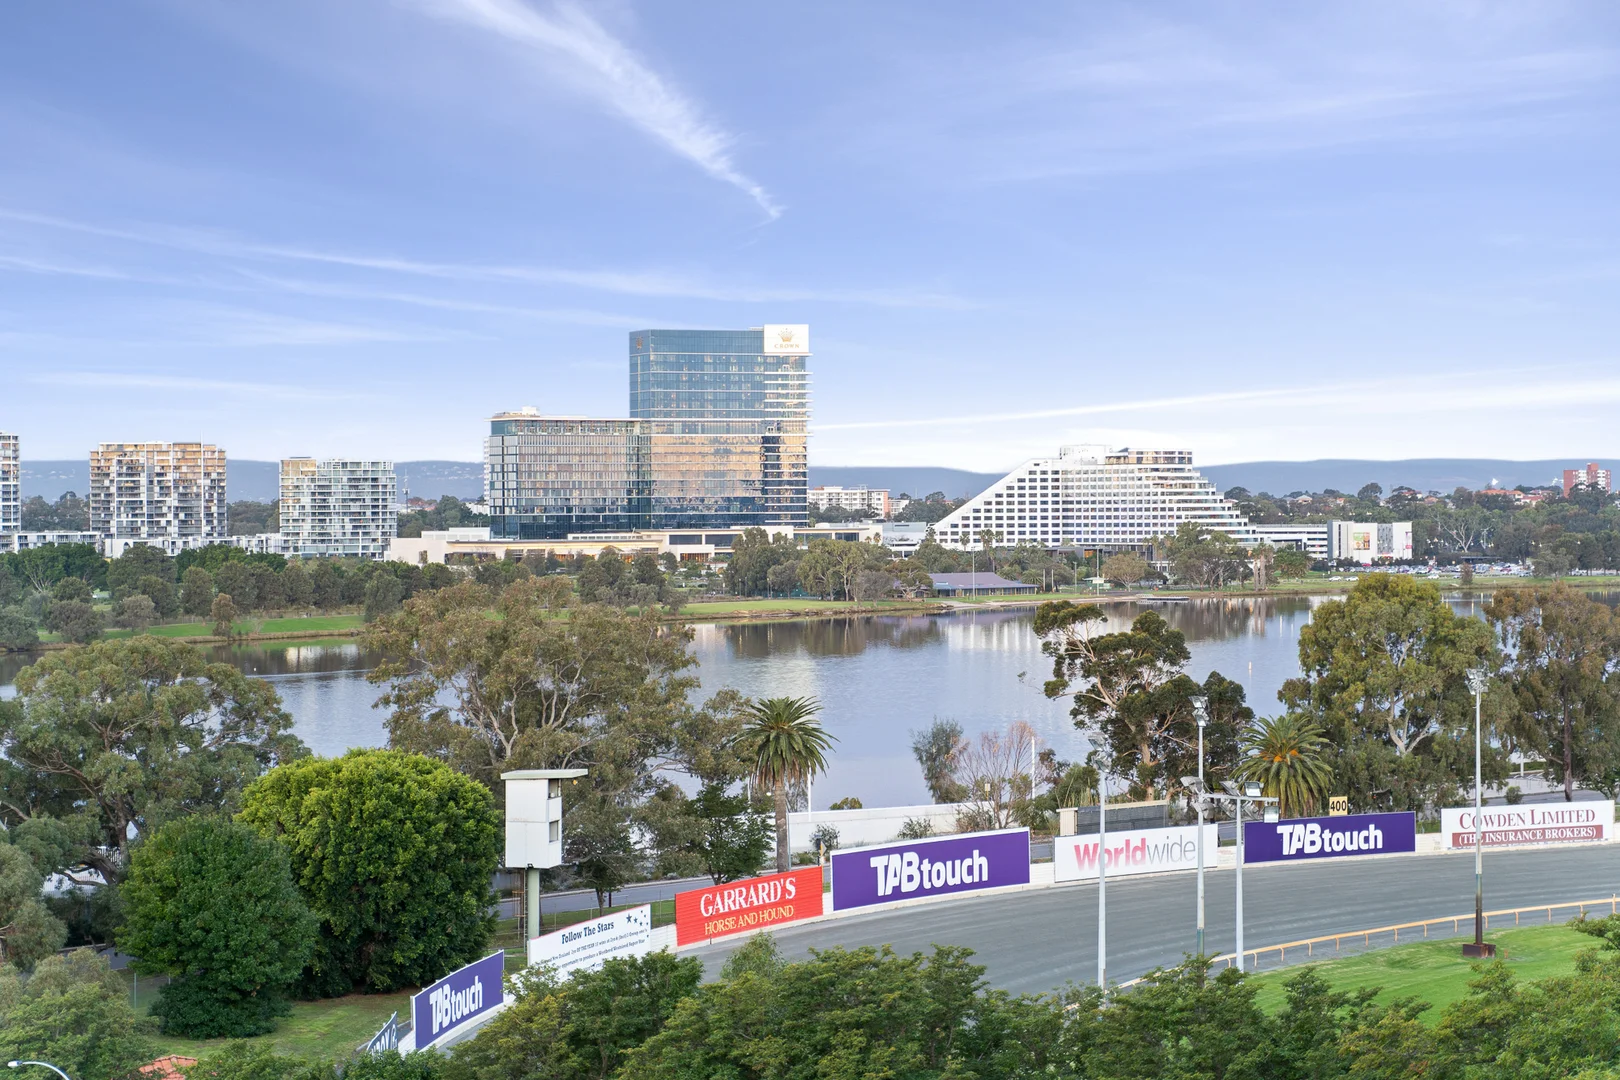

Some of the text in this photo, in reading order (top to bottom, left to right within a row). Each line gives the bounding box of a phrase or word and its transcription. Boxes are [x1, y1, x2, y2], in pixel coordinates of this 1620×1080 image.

[1330, 800, 1347, 812] 400
[1459, 808, 1596, 830] COWDEN LIMITED
[1276, 822, 1383, 856] TABtouch
[1485, 829, 1543, 844] INSURANCE
[1545, 826, 1597, 840] BROKERS)
[869, 849, 989, 897] TABtouch
[700, 877, 796, 917] GARRARD'S
[561, 932, 582, 945] Follow
[583, 925, 596, 938] The
[597, 921, 615, 934] Stars
[704, 904, 795, 936] HORSE AND HOUND
[429, 975, 483, 1035] TABtouch
